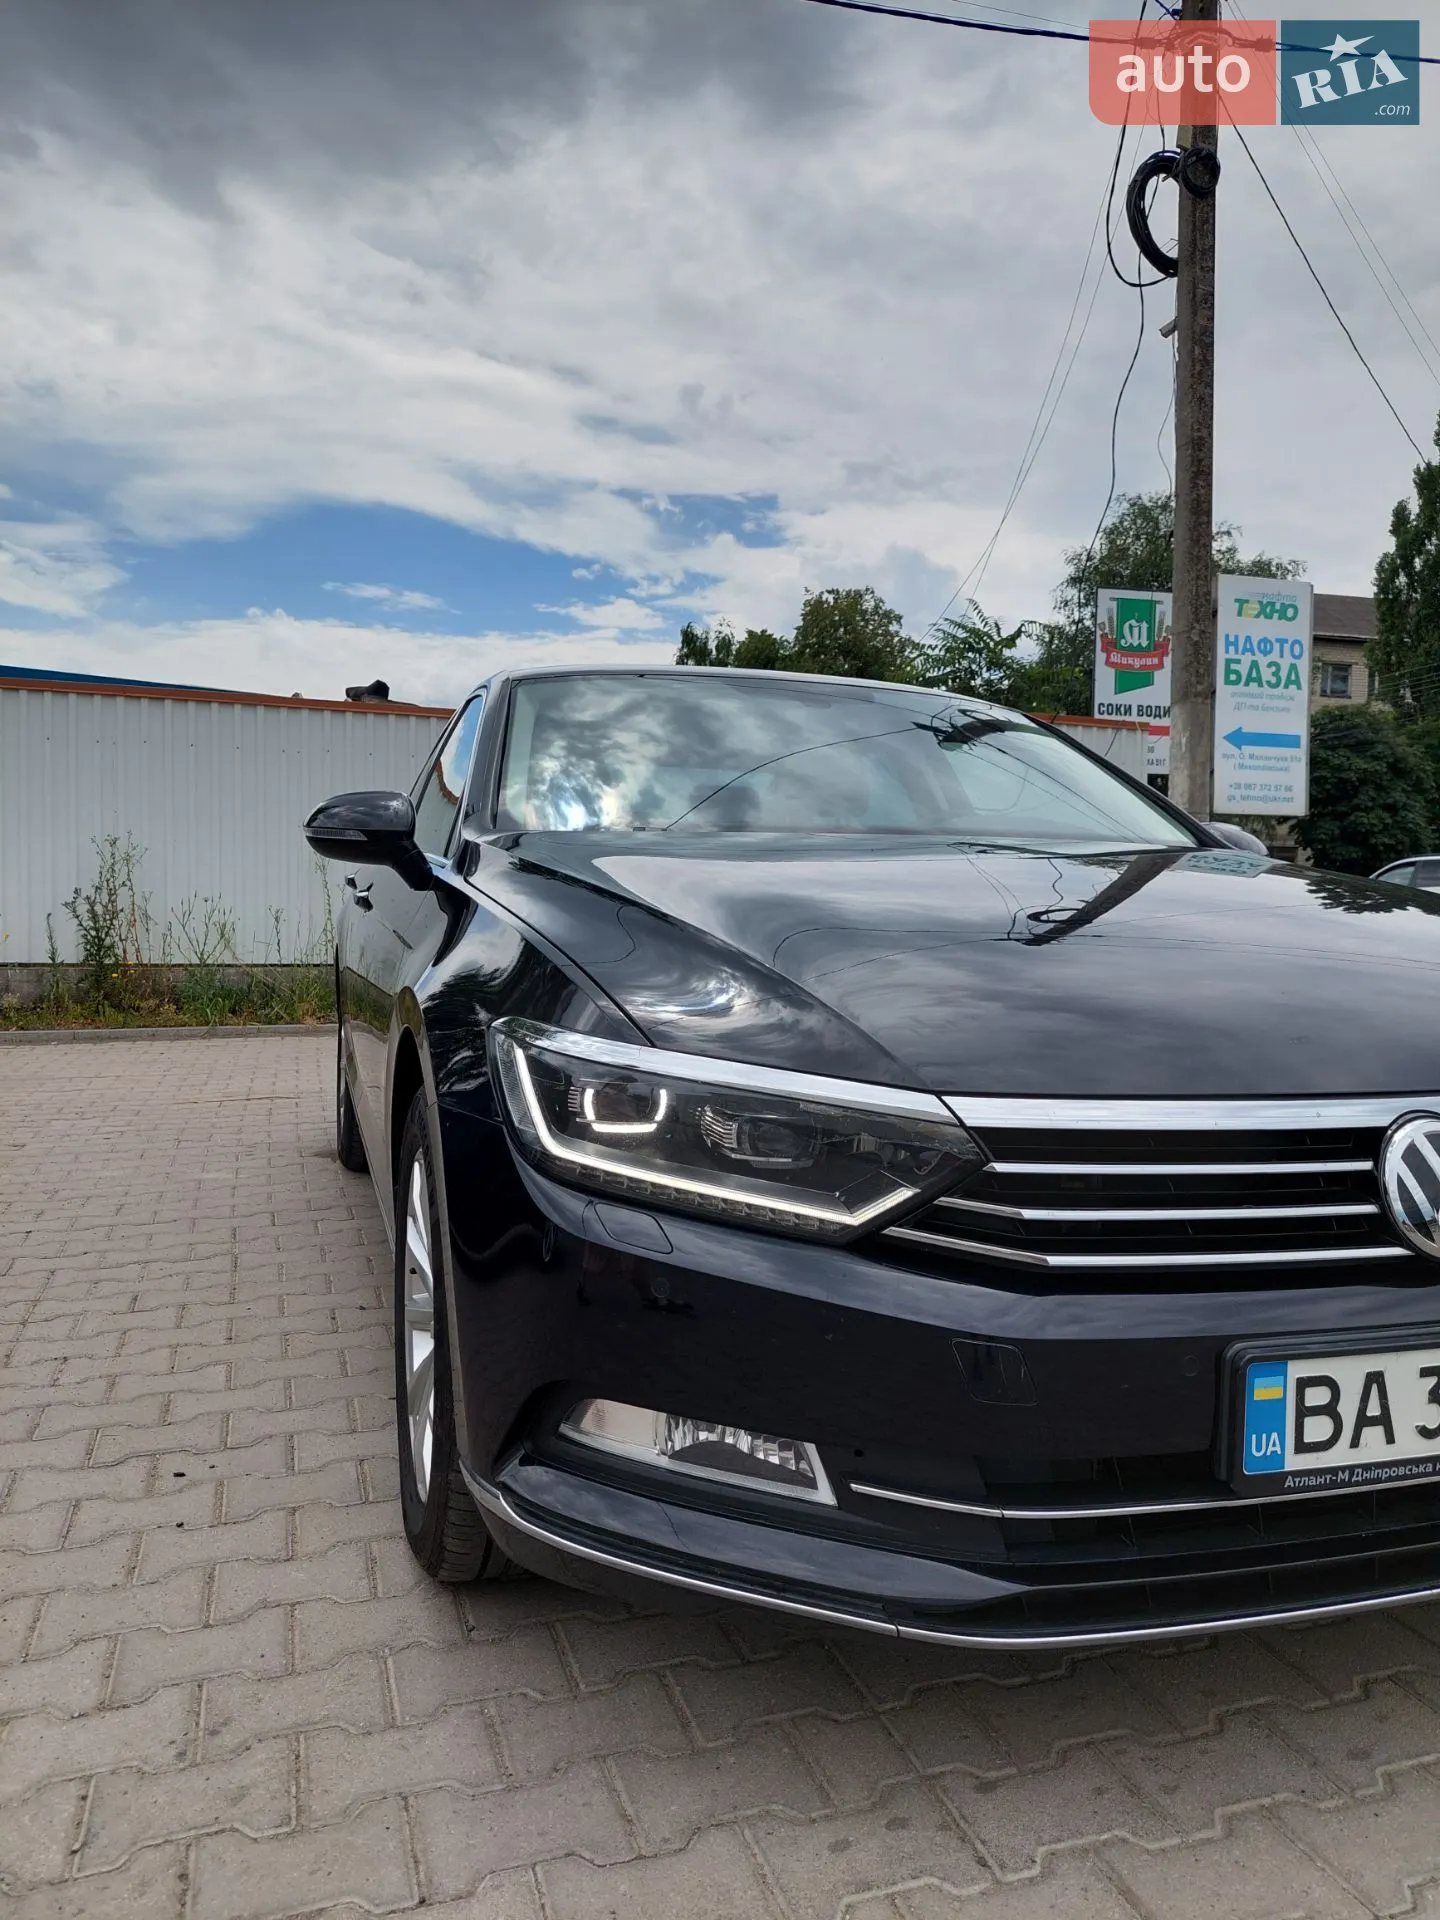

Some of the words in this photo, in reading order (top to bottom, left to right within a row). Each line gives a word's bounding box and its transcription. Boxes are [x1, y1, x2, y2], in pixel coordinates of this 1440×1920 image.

[1234, 598, 1299, 622] ТЕХНО
[1224, 633, 1304, 660] НАФТО
[1223, 658, 1303, 691] БАЗА
[1098, 703, 1132, 717] СОКИ
[1137, 704, 1171, 719] ВОДИ
[1293, 1370, 1396, 1455] BA
[1251, 1432, 1281, 1457] UA
[1284, 1472, 1349, 1488] Атлант-М
[1351, 1462, 1433, 1482] Дніпровська
